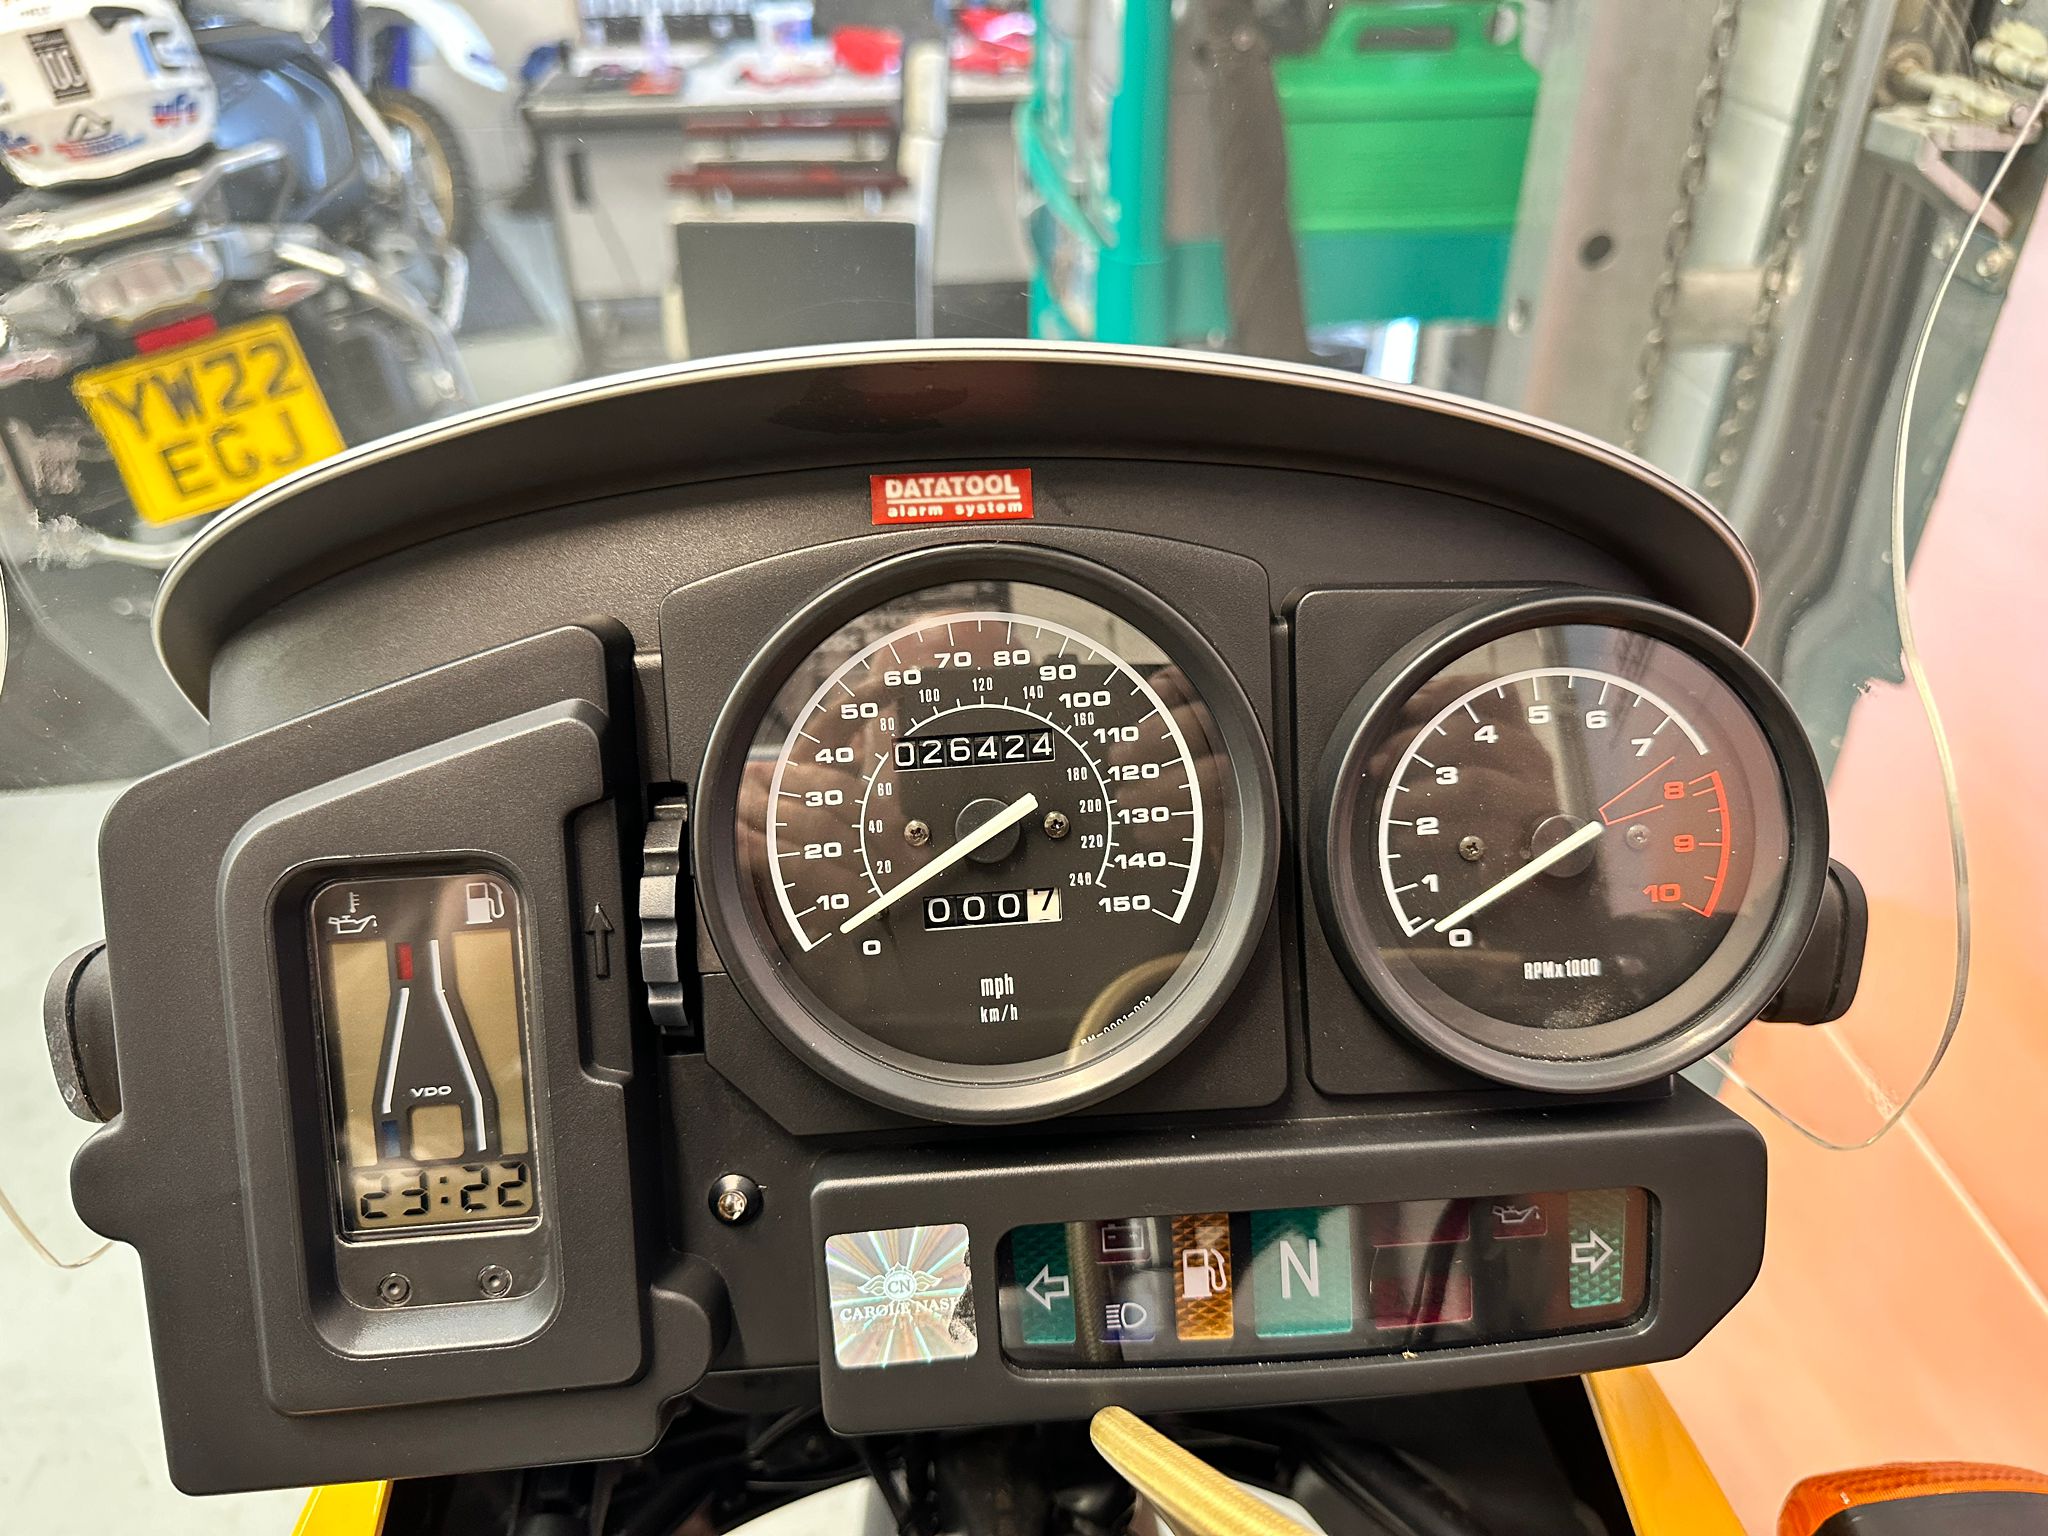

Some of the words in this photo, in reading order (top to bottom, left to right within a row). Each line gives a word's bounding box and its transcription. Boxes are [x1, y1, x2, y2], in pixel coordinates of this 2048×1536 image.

[103, 341, 302, 437] YW22
[885, 474, 1020, 498] DATATOOL
[887, 504, 944, 518] alarm
[954, 501, 1023, 518] system
[934, 651, 972, 668] 70
[993, 649, 1031, 666] 80
[884, 669, 922, 687] 60
[1039, 664, 1077, 681] 90
[972, 676, 993, 692] 120
[1022, 684, 1044, 699] 140
[919, 688, 940, 703] 100
[1058, 690, 1111, 709] 100
[840, 702, 879, 720] 50
[1073, 711, 1095, 726] 160
[1527, 705, 1551, 724] 5
[1585, 710, 1608, 729] 6
[880, 717, 895, 731] 80
[1093, 726, 1139, 743] 110
[1473, 724, 1498, 744] 4
[815, 747, 854, 764] 40
[894, 732, 1053, 767] 026424
[1631, 737, 1654, 757] 7
[1066, 766, 1088, 782] 180
[1107, 763, 1160, 781] 120
[1435, 766, 1459, 784] 3
[805, 789, 843, 807] 30
[877, 782, 893, 797] 60
[1663, 781, 1685, 799] 8
[1079, 798, 1102, 814] 200
[1117, 806, 1170, 825] 130
[868, 820, 883, 834] 40
[1415, 816, 1440, 835] 2
[803, 842, 843, 859] 20
[1080, 834, 1103, 849] 220
[1673, 834, 1695, 852] 9
[876, 860, 892, 874] 20
[1114, 851, 1167, 870] 140
[1068, 872, 1092, 887] 240
[1421, 873, 1440, 893] 1
[1642, 883, 1682, 902] 10
[816, 893, 849, 911] 10
[927, 887, 1055, 923] 0007
[1098, 894, 1151, 913] 150
[1448, 928, 1473, 947] 0
[862, 939, 881, 956] 0
[980, 973, 1015, 999] mph
[980, 1004, 1019, 1023] km/h
[410, 1085, 452, 1098] VDO
[360, 1161, 528, 1220] 23:22
[1279, 1238, 1320, 1299] N
[887, 1279, 911, 1294] CN
[839, 1299, 912, 1322] CAROLE
